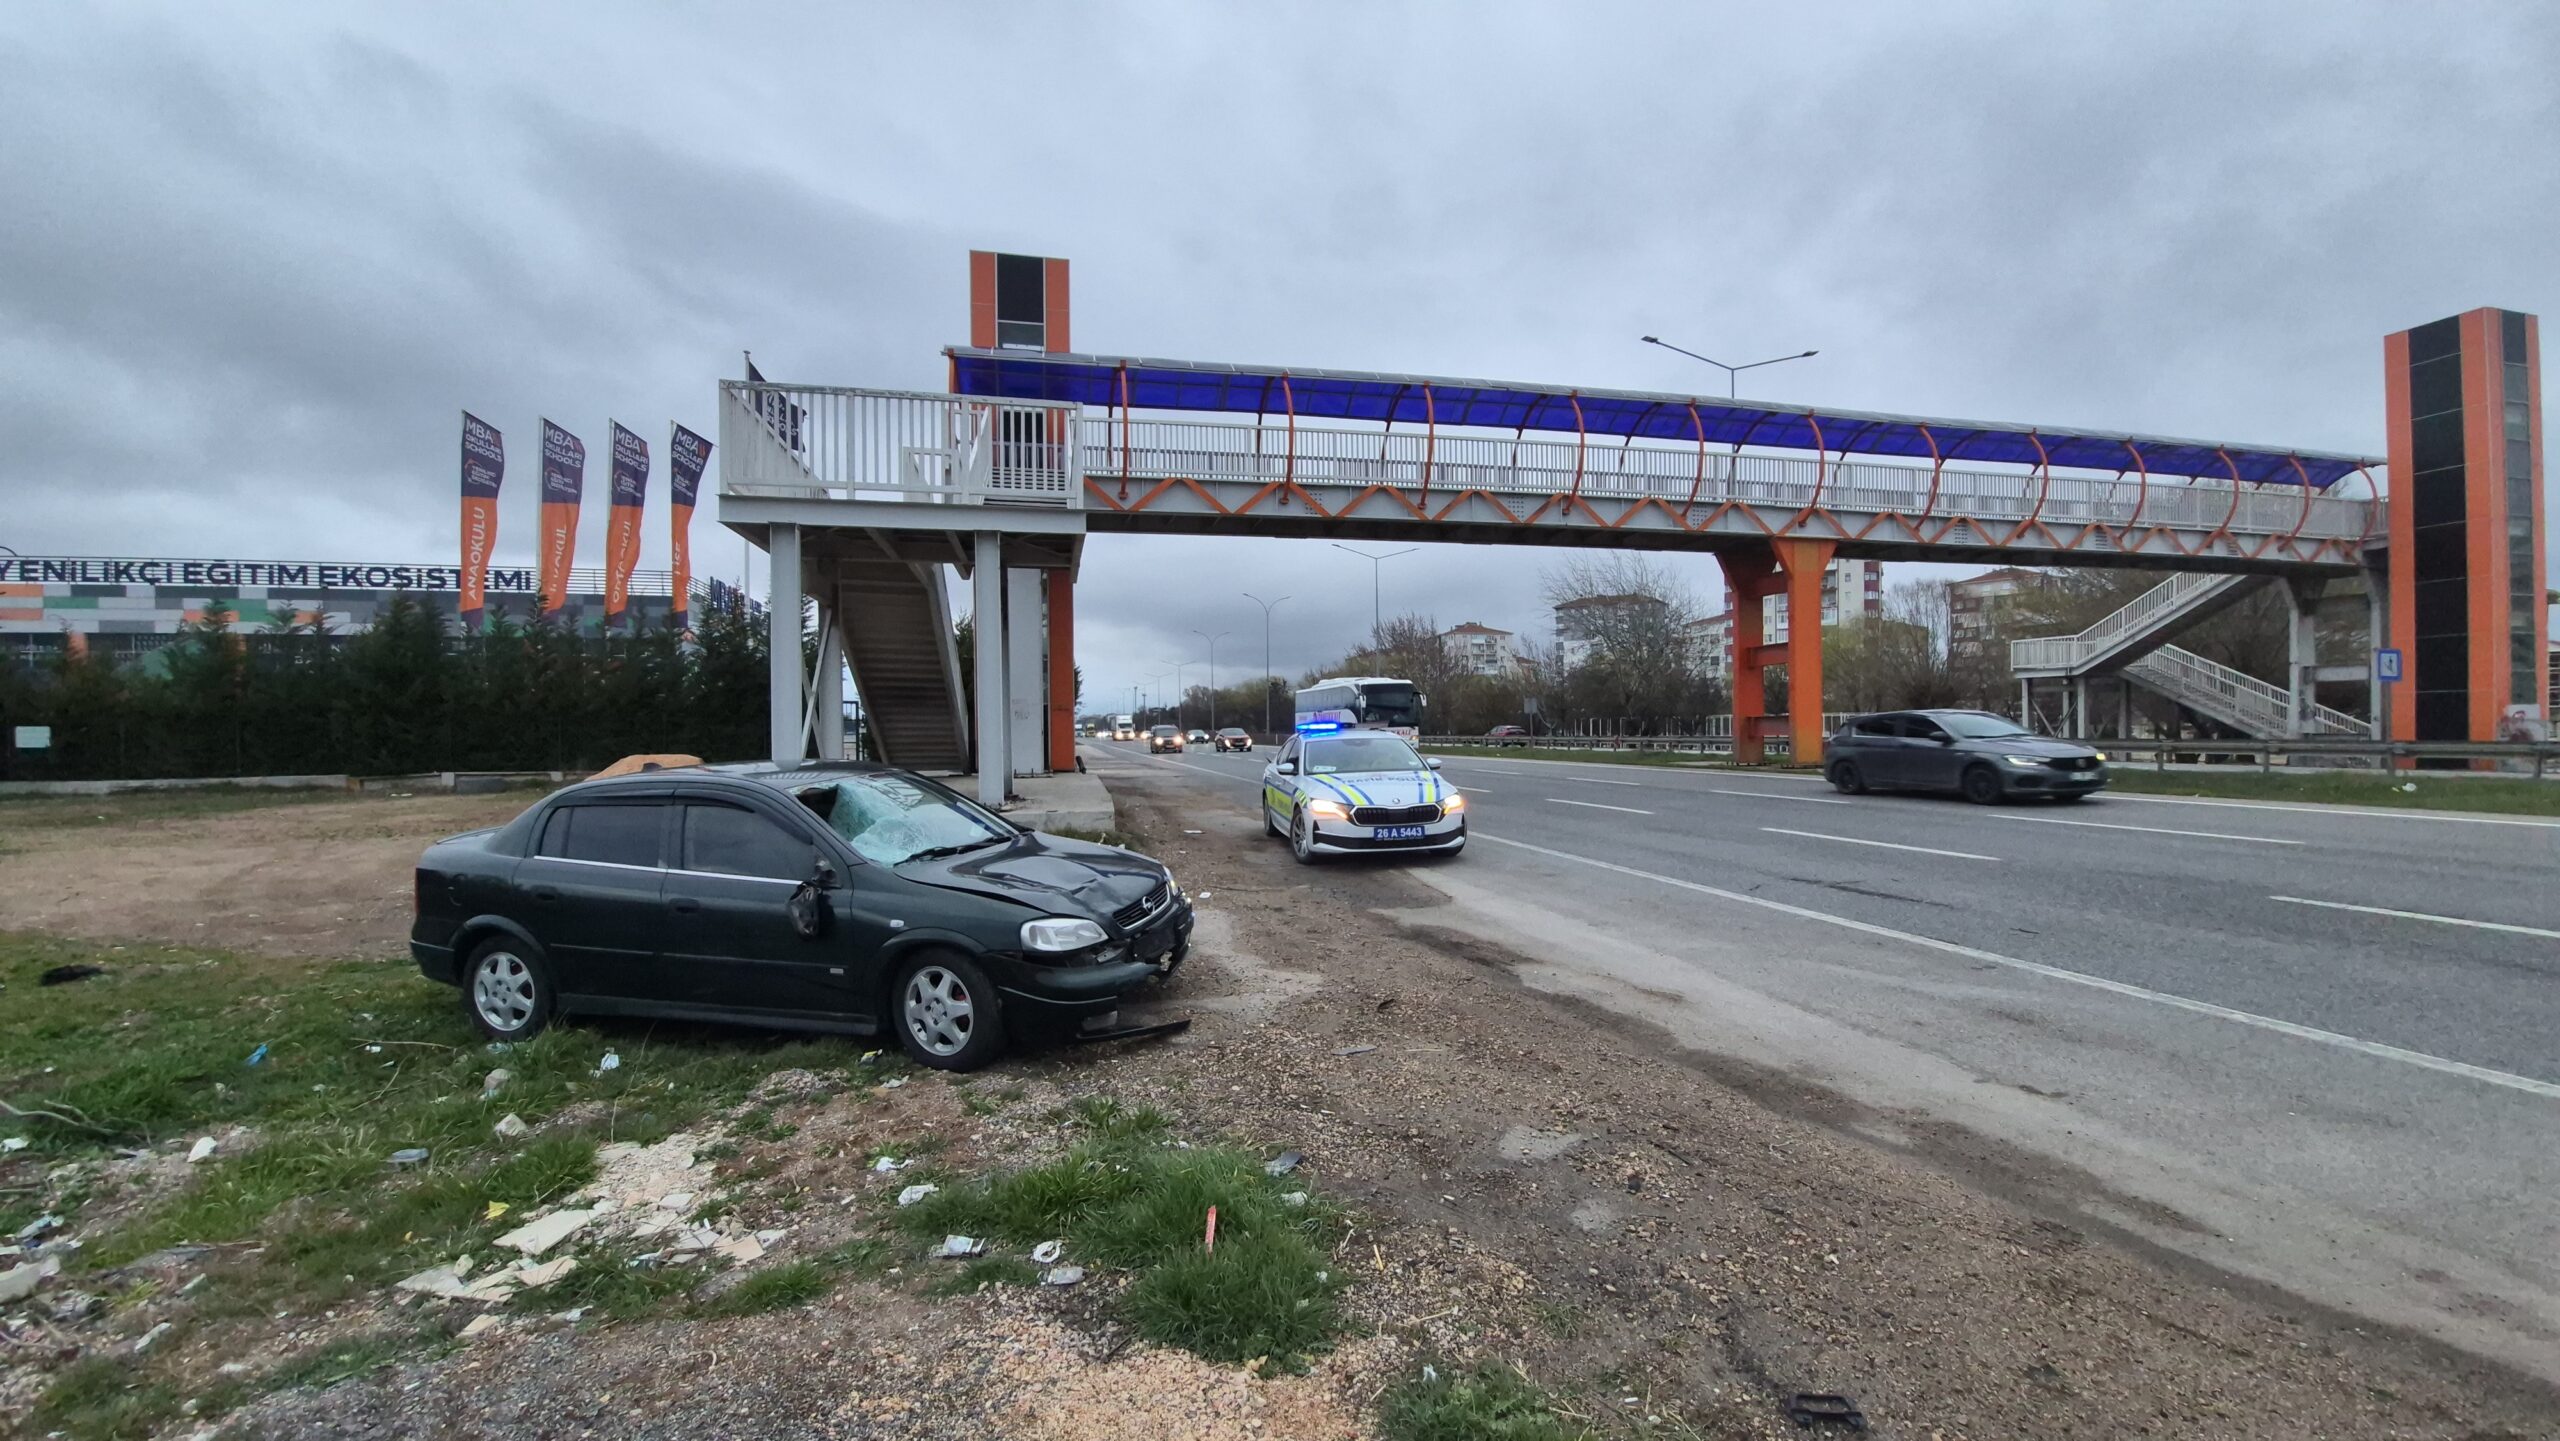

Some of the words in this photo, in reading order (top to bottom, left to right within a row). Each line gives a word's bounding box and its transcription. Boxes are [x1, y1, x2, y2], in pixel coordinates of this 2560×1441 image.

[466, 419, 494, 444] MBA
[545, 426, 575, 449] MBA
[615, 429, 641, 452] MBA
[676, 431, 699, 455] MBA
[465, 442, 502, 462] SCHOOLS
[544, 449, 581, 468] SCHOOLS
[614, 452, 648, 472] SCHOOLS
[672, 451, 700, 472] SCHOOLS
[467, 507, 485, 600] ANAOKULU
[183, 559, 308, 586] EĞİTİM
[1377, 828, 1389, 838] 26
[1391, 828, 1398, 838] A
[1400, 827, 1422, 838] 5443
